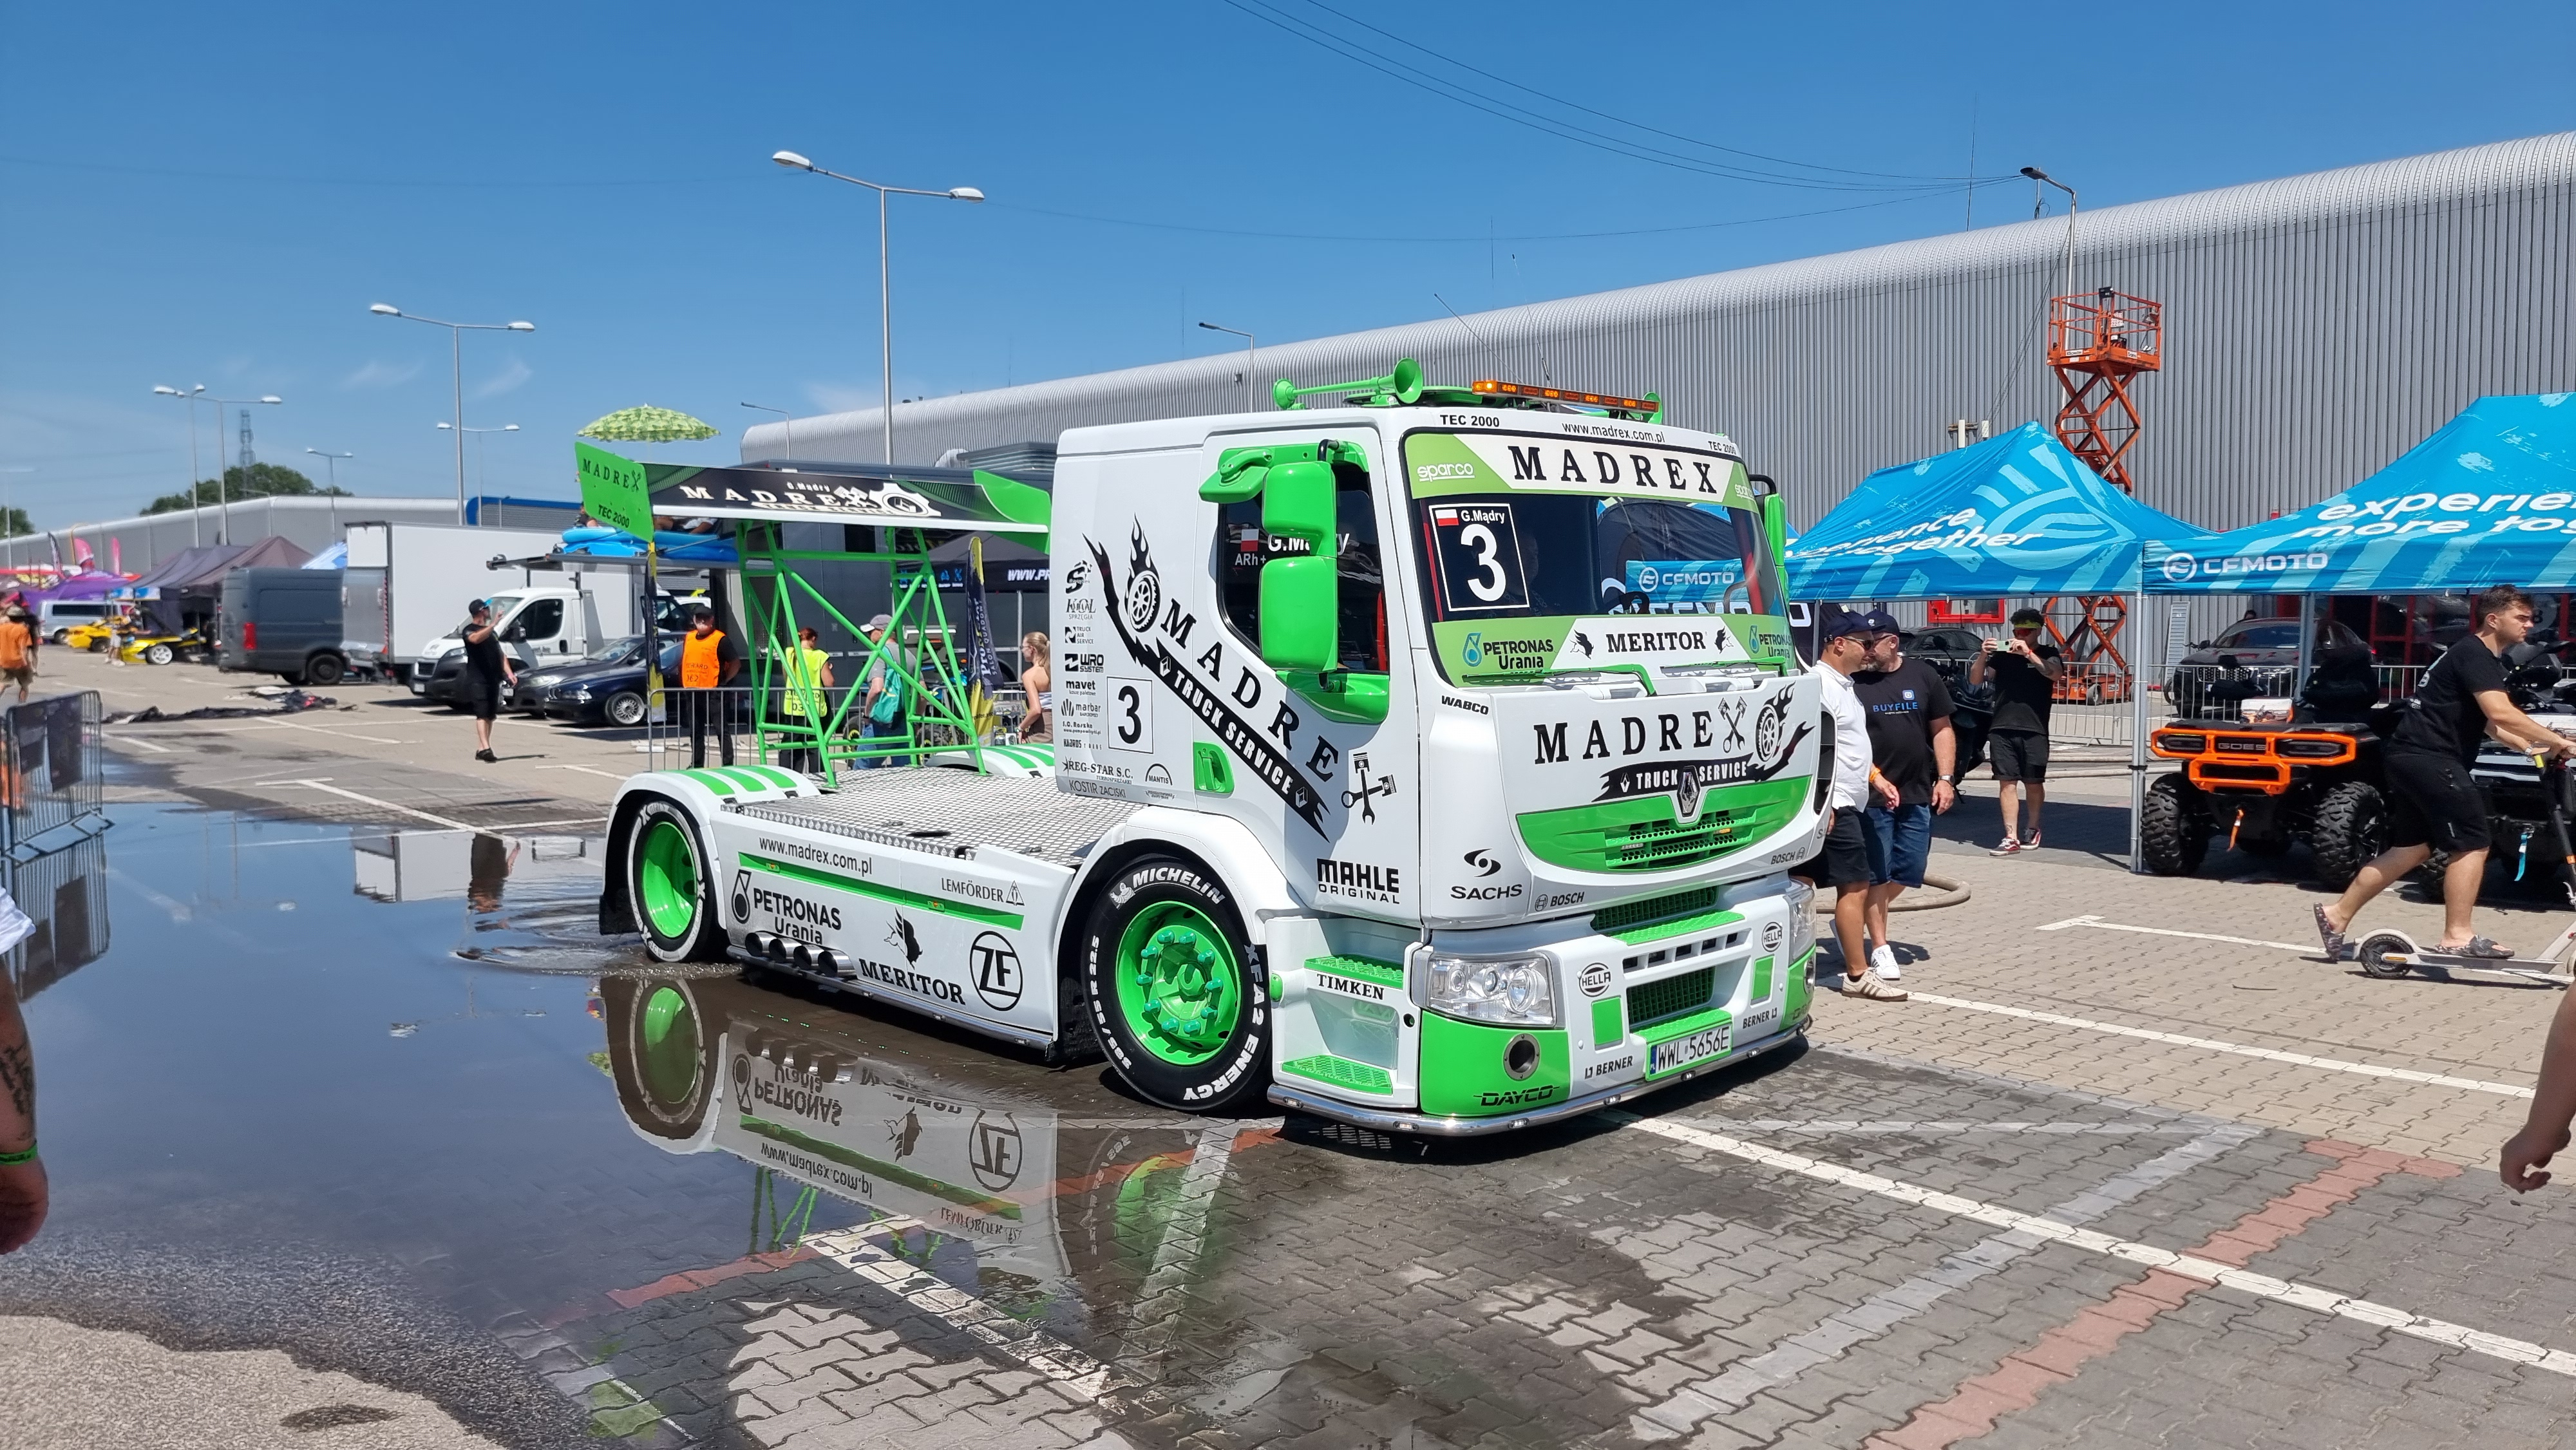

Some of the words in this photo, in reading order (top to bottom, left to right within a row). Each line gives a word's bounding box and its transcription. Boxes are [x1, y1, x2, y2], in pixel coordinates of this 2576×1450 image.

[1440, 415, 1466, 425] TEC
[1471, 415, 1500, 427] 2000
[1562, 423, 1665, 443] www.madrex.com.pl
[1708, 440, 1722, 452] TEC
[1417, 463, 1473, 482] sparco
[1508, 446, 1717, 494] MADREX
[598, 504, 612, 519] TEC
[613, 512, 630, 528] 2000
[1461, 509, 1505, 523] G.Mądry
[2317, 492, 2576, 520] experie
[2291, 519, 2470, 538] more
[1460, 523, 1506, 601] 3
[2203, 553, 2328, 574] CFMOTO
[1662, 572, 1734, 585] CFMOTO
[1483, 639, 1554, 655] PETRONAS
[1606, 632, 1706, 653] MERITOR
[1080, 654, 1104, 666] WRO
[1499, 655, 1544, 670] Urania
[1066, 681, 1095, 690] mavet
[1075, 702, 1101, 712] marbar
[1118, 685, 1142, 744] 3
[1441, 695, 1489, 715] WABCO
[1873, 702, 1918, 712] BUYFILE
[1173, 669, 1224, 728] TRUCK
[1226, 721, 1293, 795] SERVICE
[1068, 760, 1114, 776] REG-STAR
[1117, 767, 1133, 779] S.C.
[1148, 775, 1169, 784] MANTIS
[1636, 769, 1678, 789] TRUCK
[1699, 762, 1747, 782] SERVICE
[1069, 780, 1098, 795] KOSTIR
[1099, 786, 1126, 798] ZACISKI
[759, 837, 873, 877] www.madrex.com.pl
[1771, 851, 1795, 865] BOSCH
[1316, 858, 1399, 893] MAHLE
[942, 878, 1004, 903] LEMFÖRDER
[1133, 867, 1226, 905] MICHELIN
[1318, 883, 1400, 905] ORIGINAL
[1450, 884, 1522, 900] SACHS
[753, 887, 842, 930] PETRONAS
[1550, 892, 1585, 907] BOSCH
[775, 916, 822, 945] Urania
[1763, 930, 1783, 943] HELLA
[858, 958, 966, 1006] MERITOR
[972, 945, 1021, 999] ZF
[1582, 971, 1611, 987] HELLA
[1317, 974, 1385, 1000] TIMKEN
[1743, 1010, 1770, 1029] BERNER
[1658, 1041, 1683, 1071] WWL
[1689, 1026, 1730, 1060] 5656E
[1183, 1033, 1260, 1101] ENERGY
[1596, 1055, 1633, 1076] BERNER
[1479, 1085, 1555, 1107] DAYCO
